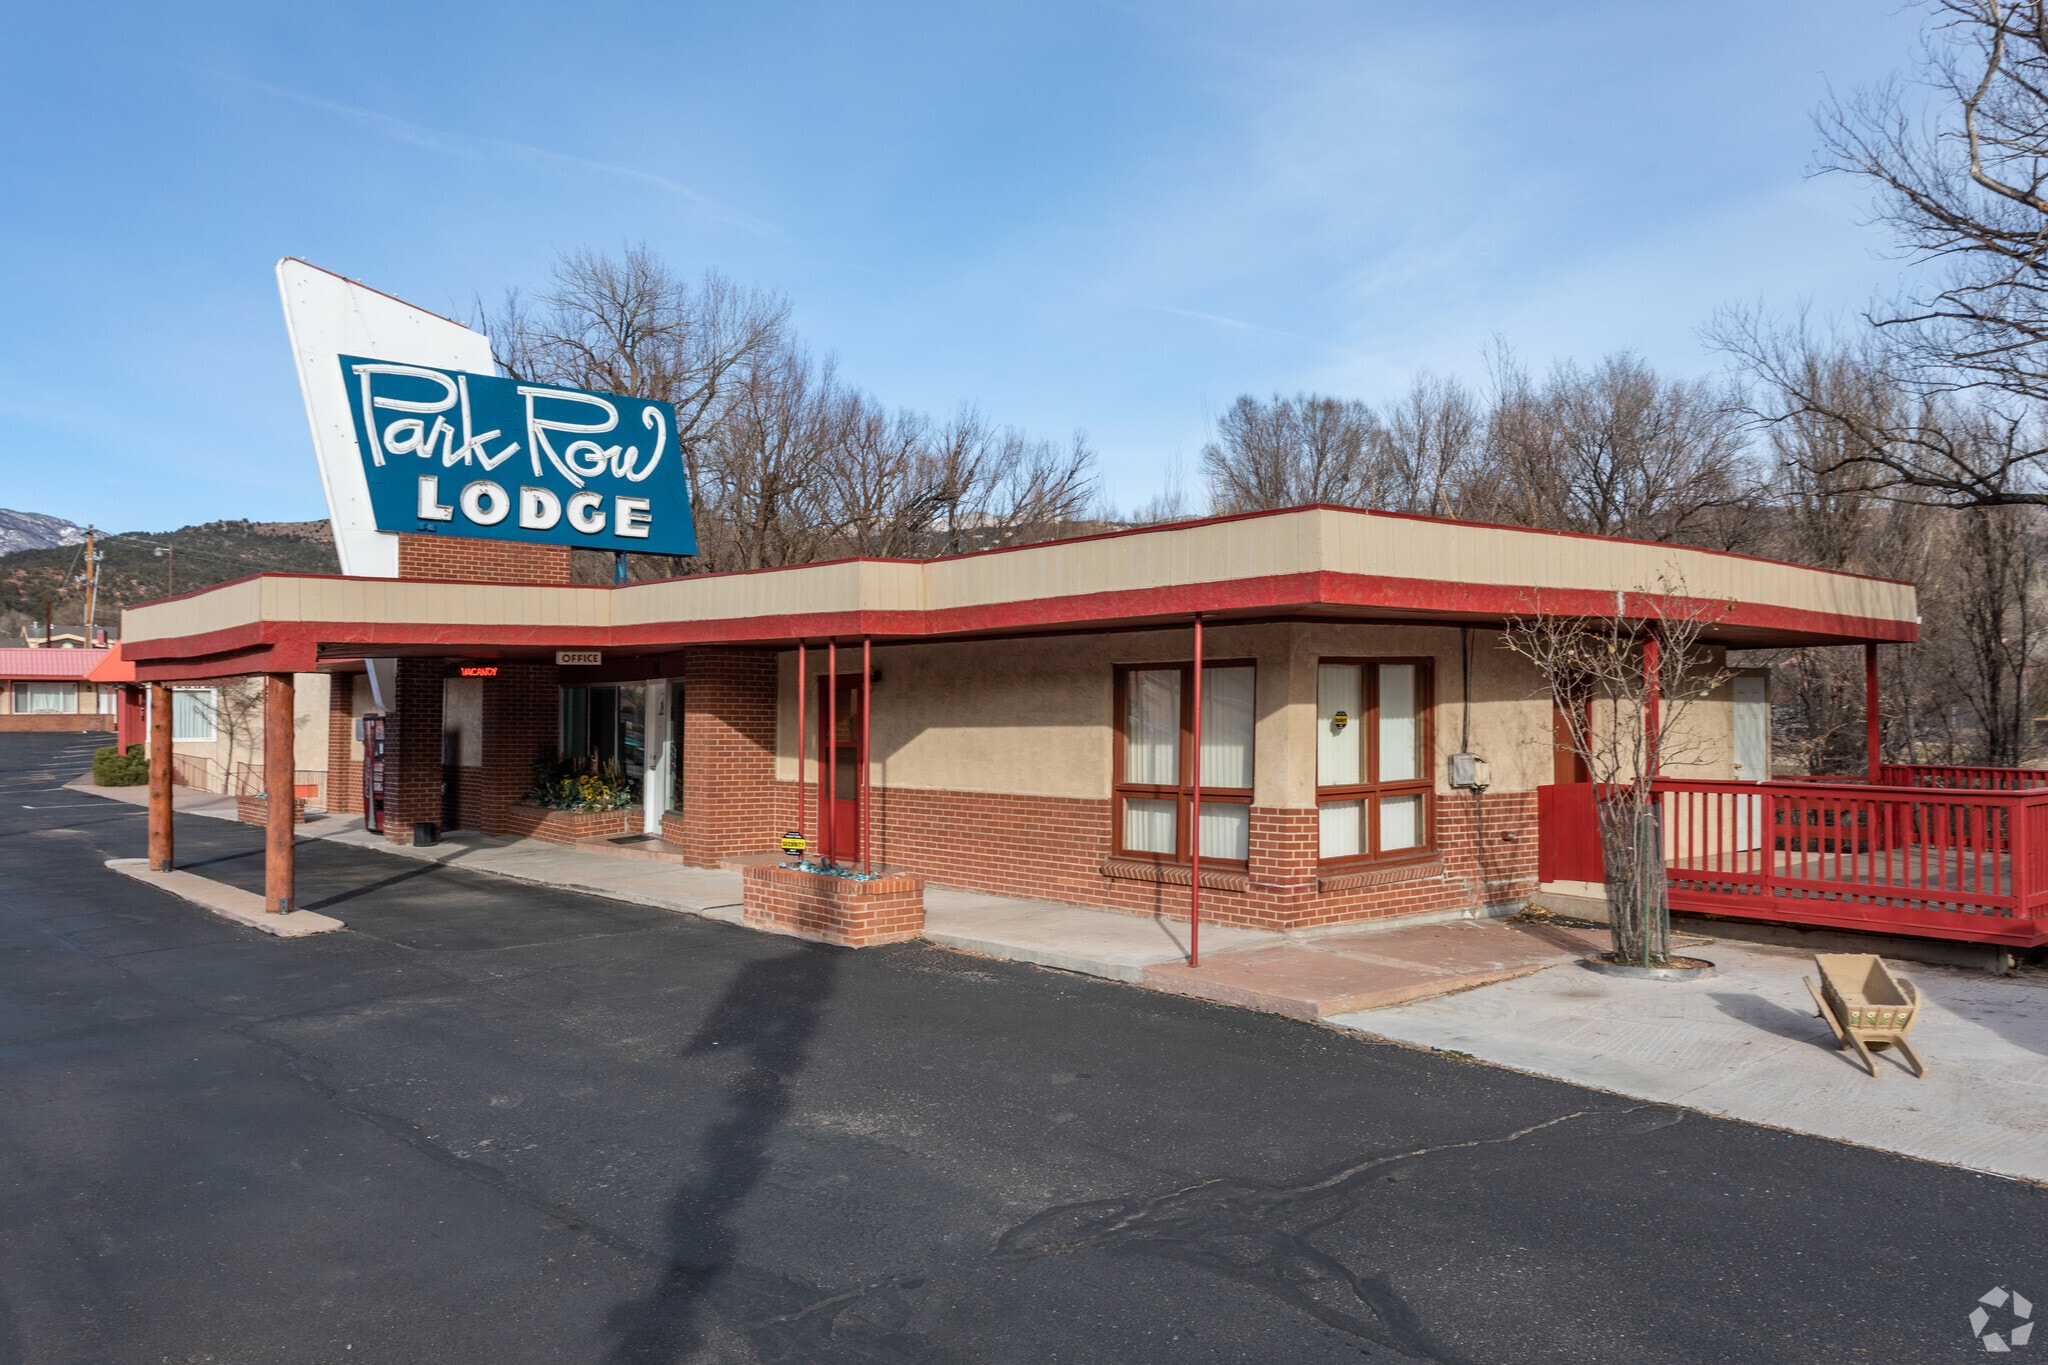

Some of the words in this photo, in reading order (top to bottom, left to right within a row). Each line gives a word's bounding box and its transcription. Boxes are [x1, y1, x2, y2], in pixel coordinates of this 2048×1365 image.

[351, 363, 521, 471] Park
[516, 385, 667, 488] Row
[416, 474, 652, 539] LODGE
[460, 667, 498, 677] VACANCY
[562, 654, 599, 663] OFFICE
